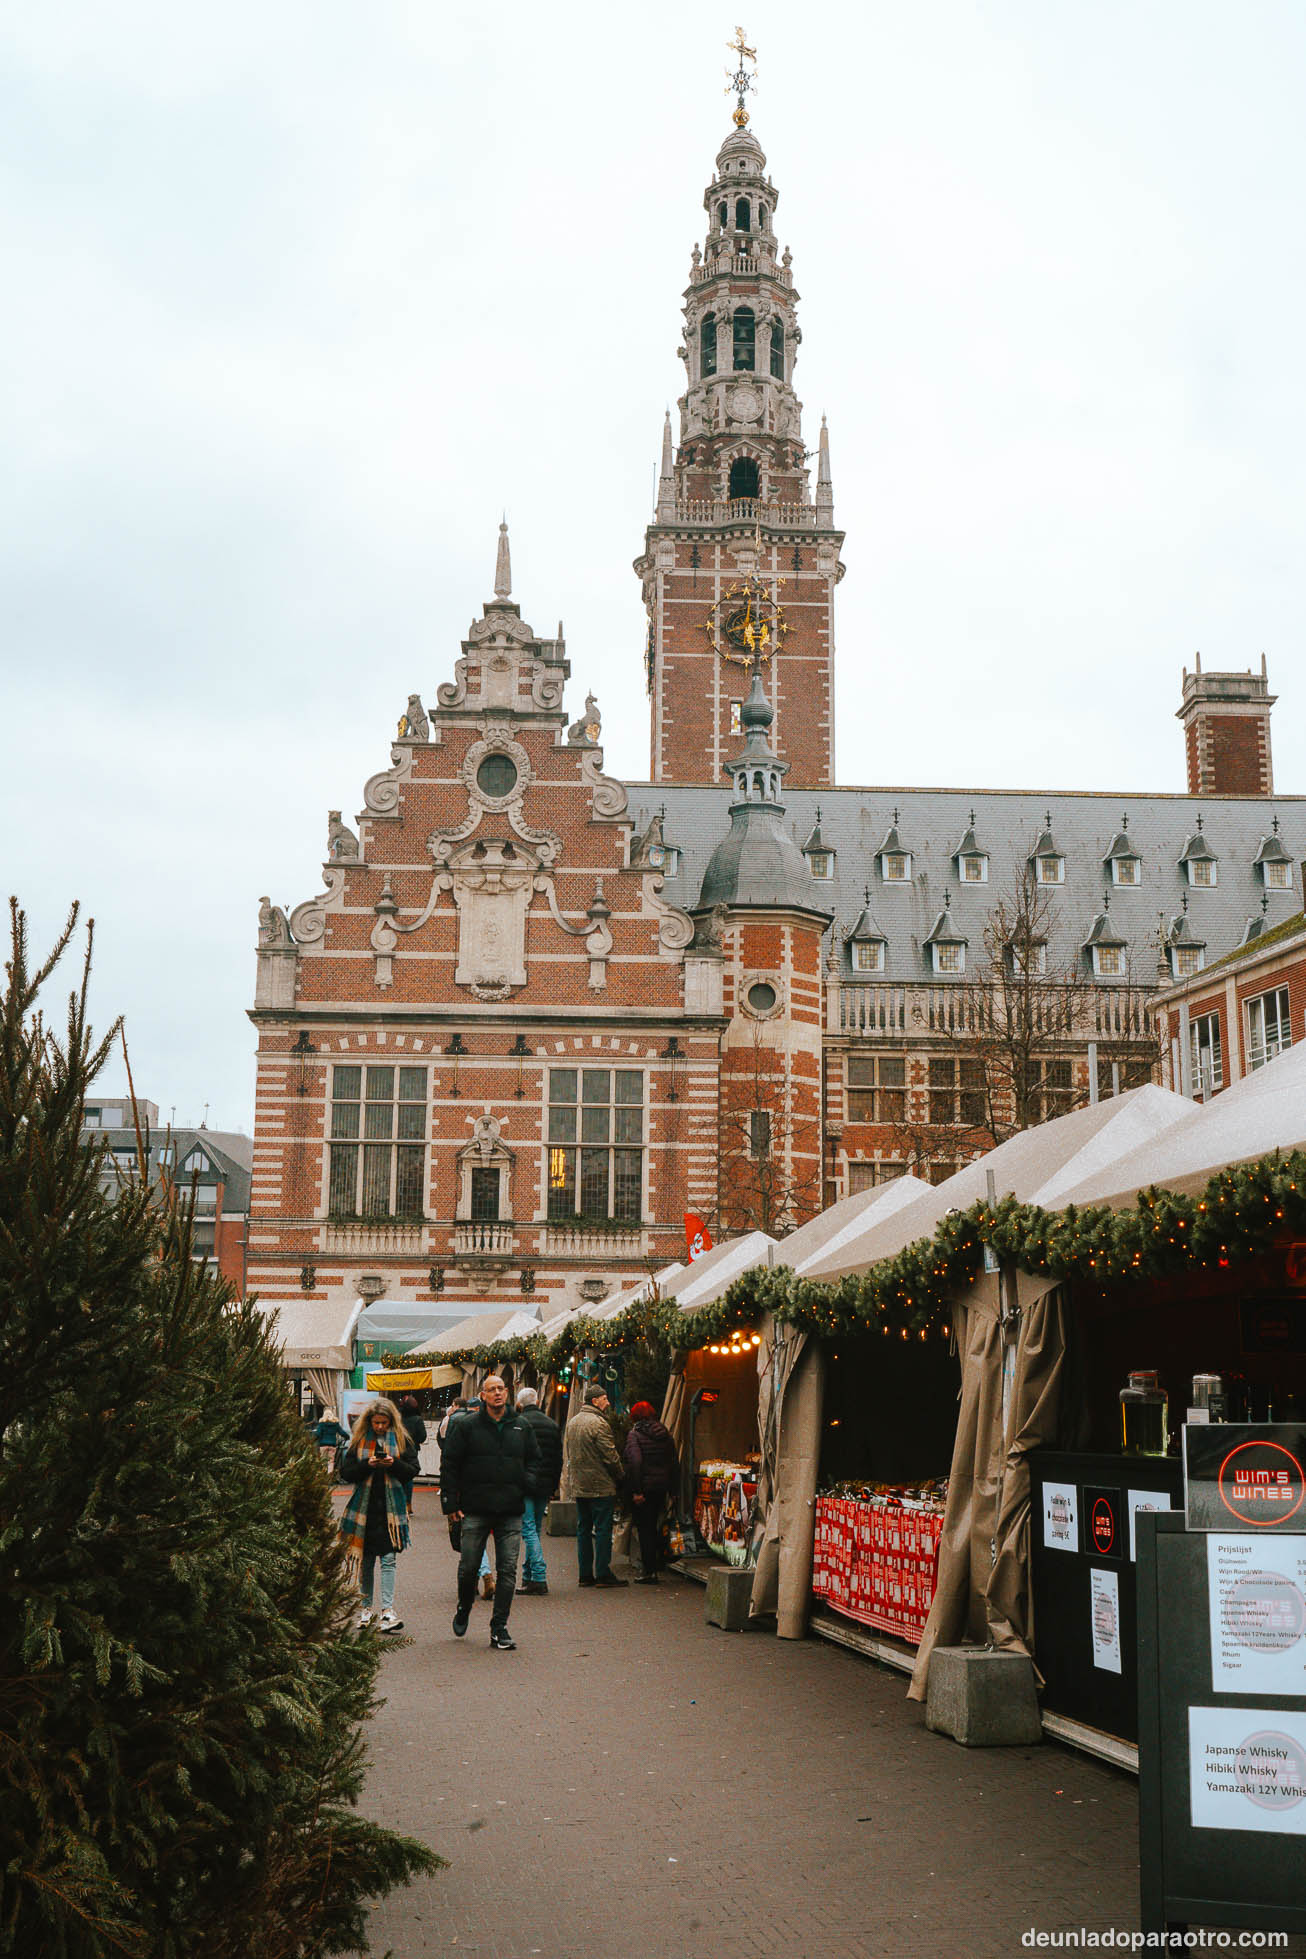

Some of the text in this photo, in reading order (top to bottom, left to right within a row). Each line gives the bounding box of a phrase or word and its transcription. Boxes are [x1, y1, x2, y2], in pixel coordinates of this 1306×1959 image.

[1235, 1470, 1289, 1484] WIM'S
[1233, 1486, 1293, 1499] WINES
[1218, 1545, 1252, 1555] Prijslijst
[1218, 1568, 1232, 1576] Wijn
[1205, 1744, 1289, 1760] Japanse Whisky
[1206, 1763, 1278, 1778] Hibiki Whisky
[1206, 1781, 1255, 1794] Yamazaki
[1258, 1784, 1278, 1795] 12Y
